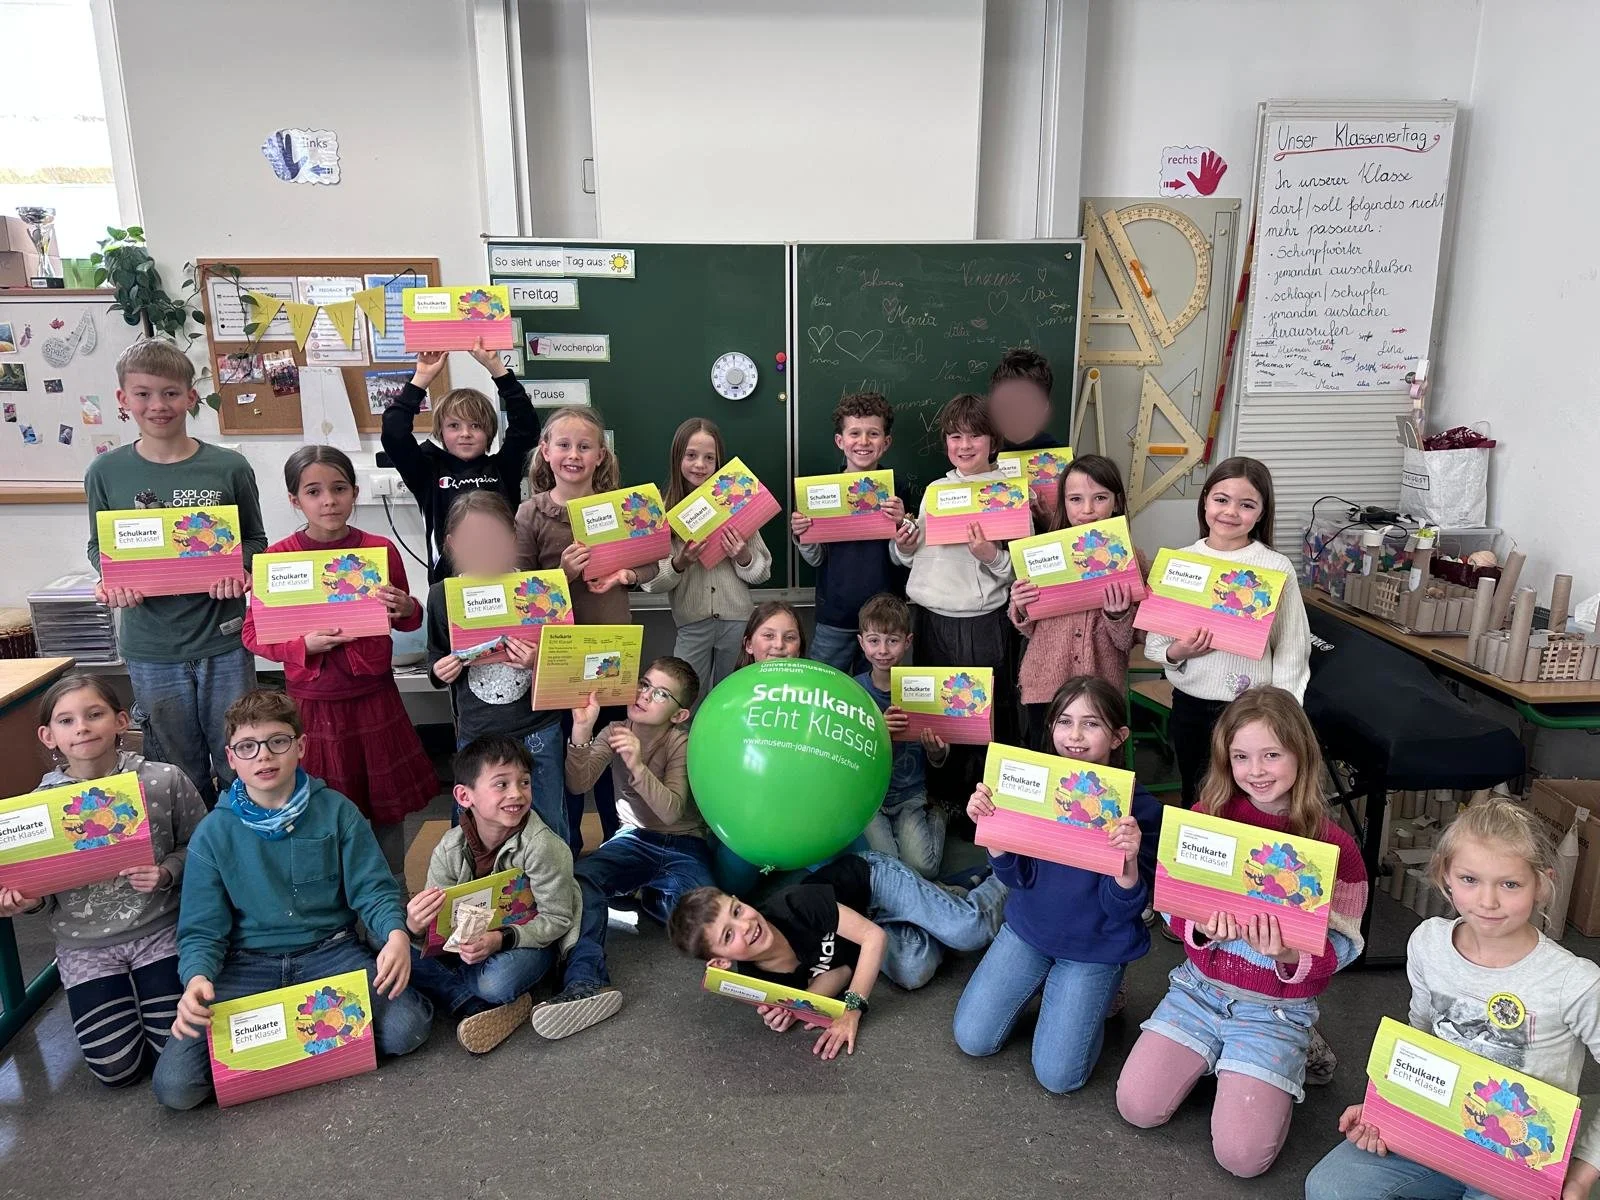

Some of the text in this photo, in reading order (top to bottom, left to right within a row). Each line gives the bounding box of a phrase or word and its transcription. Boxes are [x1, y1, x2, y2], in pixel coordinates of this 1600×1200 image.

[1277, 122, 1427, 151] Unser Klassenvertrag
[1168, 155, 1198, 165] rechts
[1275, 161, 1414, 190] In unserer Klasse
[1265, 219, 1301, 237] mehr
[495, 255, 606, 268] So sieht unser Tag aus:
[513, 287, 558, 303] Freitag
[553, 343, 605, 354] Wochenplan
[504, 354, 518, 368] 2.
[533, 389, 565, 399] Pause
[173, 489, 222, 500] EXPLORE
[809, 493, 837, 501] Schulkarte
[940, 494, 967, 502] Schulkarte
[173, 498, 196, 507] OFF
[586, 513, 612, 524] Schulkarte
[685, 505, 708, 525] Schulkarte
[118, 529, 158, 538] Schulkarte
[1028, 554, 1060, 566] Schulkarte
[271, 572, 308, 581] Schulkarte
[1168, 568, 1202, 580] Schulkarte
[467, 597, 501, 607] Schulkarte
[752, 683, 876, 733] Schulkarte
[746, 706, 878, 761] Echt Klasse!
[1002, 773, 1041, 788] Schulkarte
[1180, 849, 1198, 861] Echt
[1181, 840, 1227, 860] Schulkarte
[234, 1020, 279, 1037] Schulkarte
[235, 1034, 253, 1045] Echt
[1393, 1066, 1413, 1083] Echt
[1395, 1058, 1446, 1088] Schulkarte
